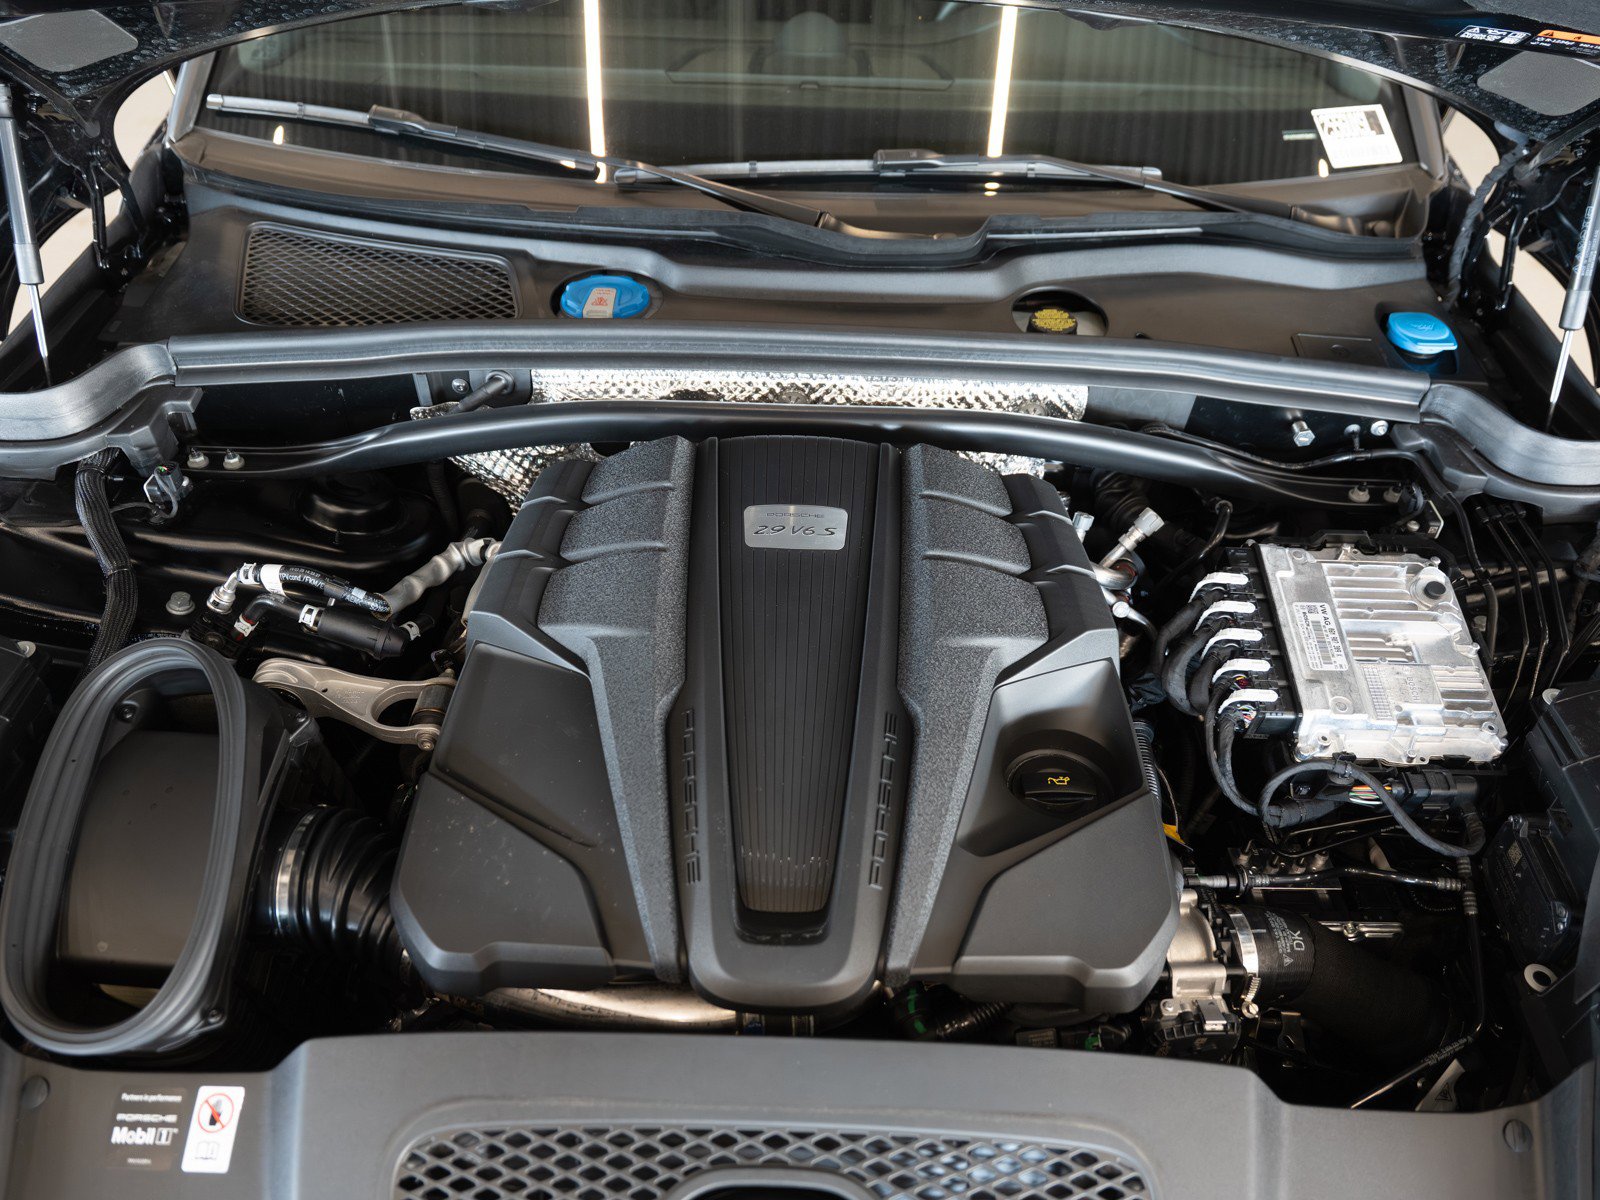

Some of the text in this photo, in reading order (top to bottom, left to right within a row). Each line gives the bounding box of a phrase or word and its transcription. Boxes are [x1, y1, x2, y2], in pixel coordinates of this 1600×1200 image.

[753, 525, 838, 537] 2.9 V6 S
[1320, 604, 1328, 616] VW
[1323, 616, 1331, 626] AG
[1406, 676, 1420, 701] BOSCH
[683, 708, 700, 886] PORSCHE
[868, 711, 897, 890] PORSCHE
[1289, 930, 1305, 951] DK
[116, 1113, 178, 1123] PORSCHE
[111, 1126, 156, 1146] Mobil
